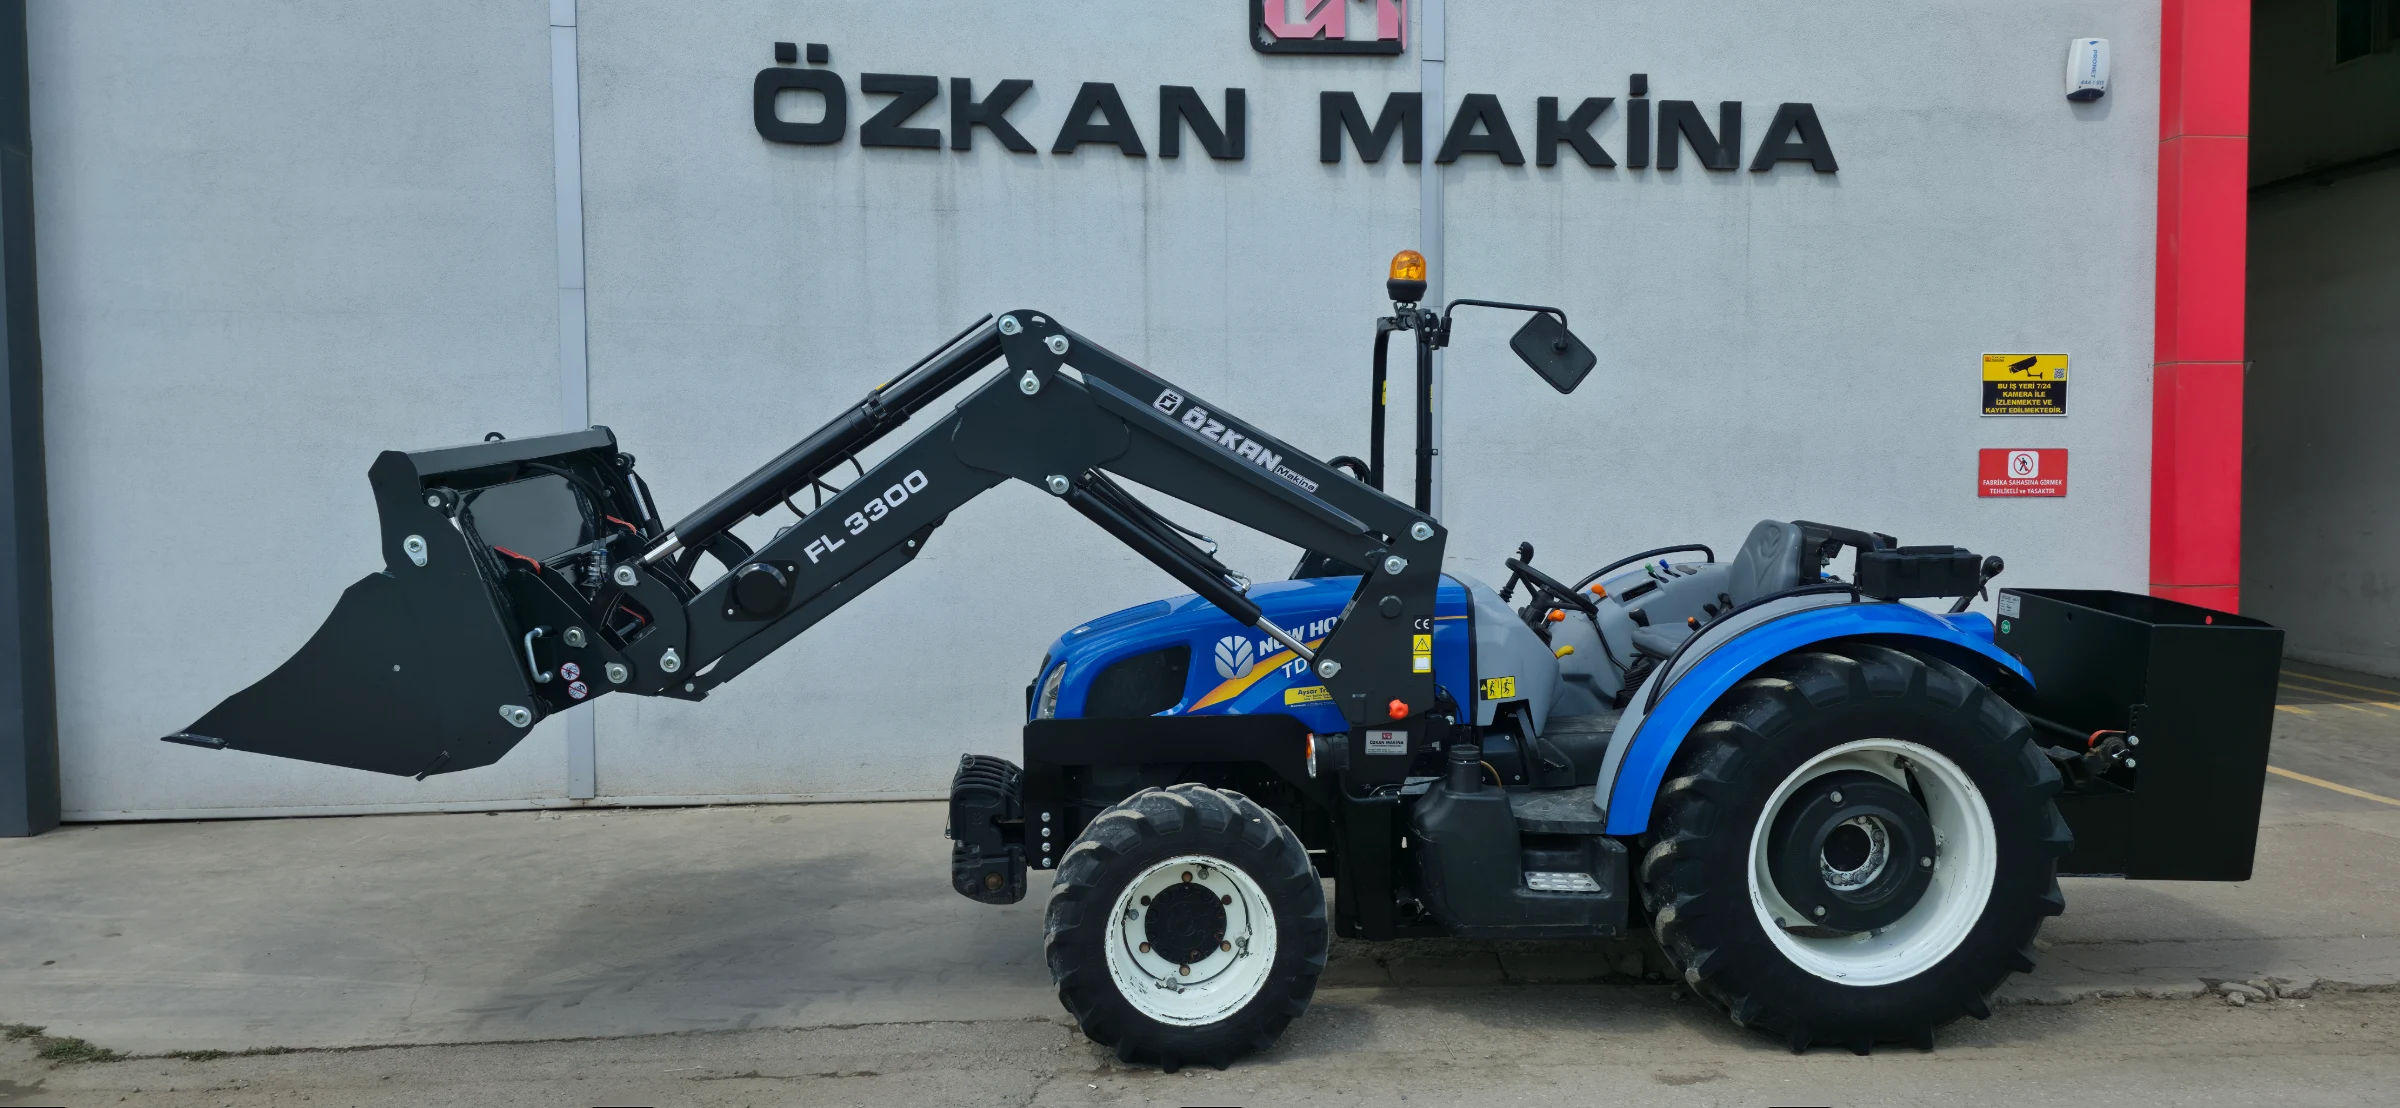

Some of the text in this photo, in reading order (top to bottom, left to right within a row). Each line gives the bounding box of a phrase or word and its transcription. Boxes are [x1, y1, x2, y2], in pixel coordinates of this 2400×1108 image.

[754, 42, 1839, 173] ÖZKAN MAKİNA
[2009, 382, 2017, 390] İŞ
[2034, 390, 2046, 398] İLE
[1995, 398, 2042, 406] İZLENMEKTE
[1181, 405, 1283, 472] ÖZKAN
[1276, 465, 1317, 492] Makina
[803, 469, 929, 565] FL 3300
[1414, 618, 1430, 630] CE
[1297, 689, 1318, 697] Aysar
